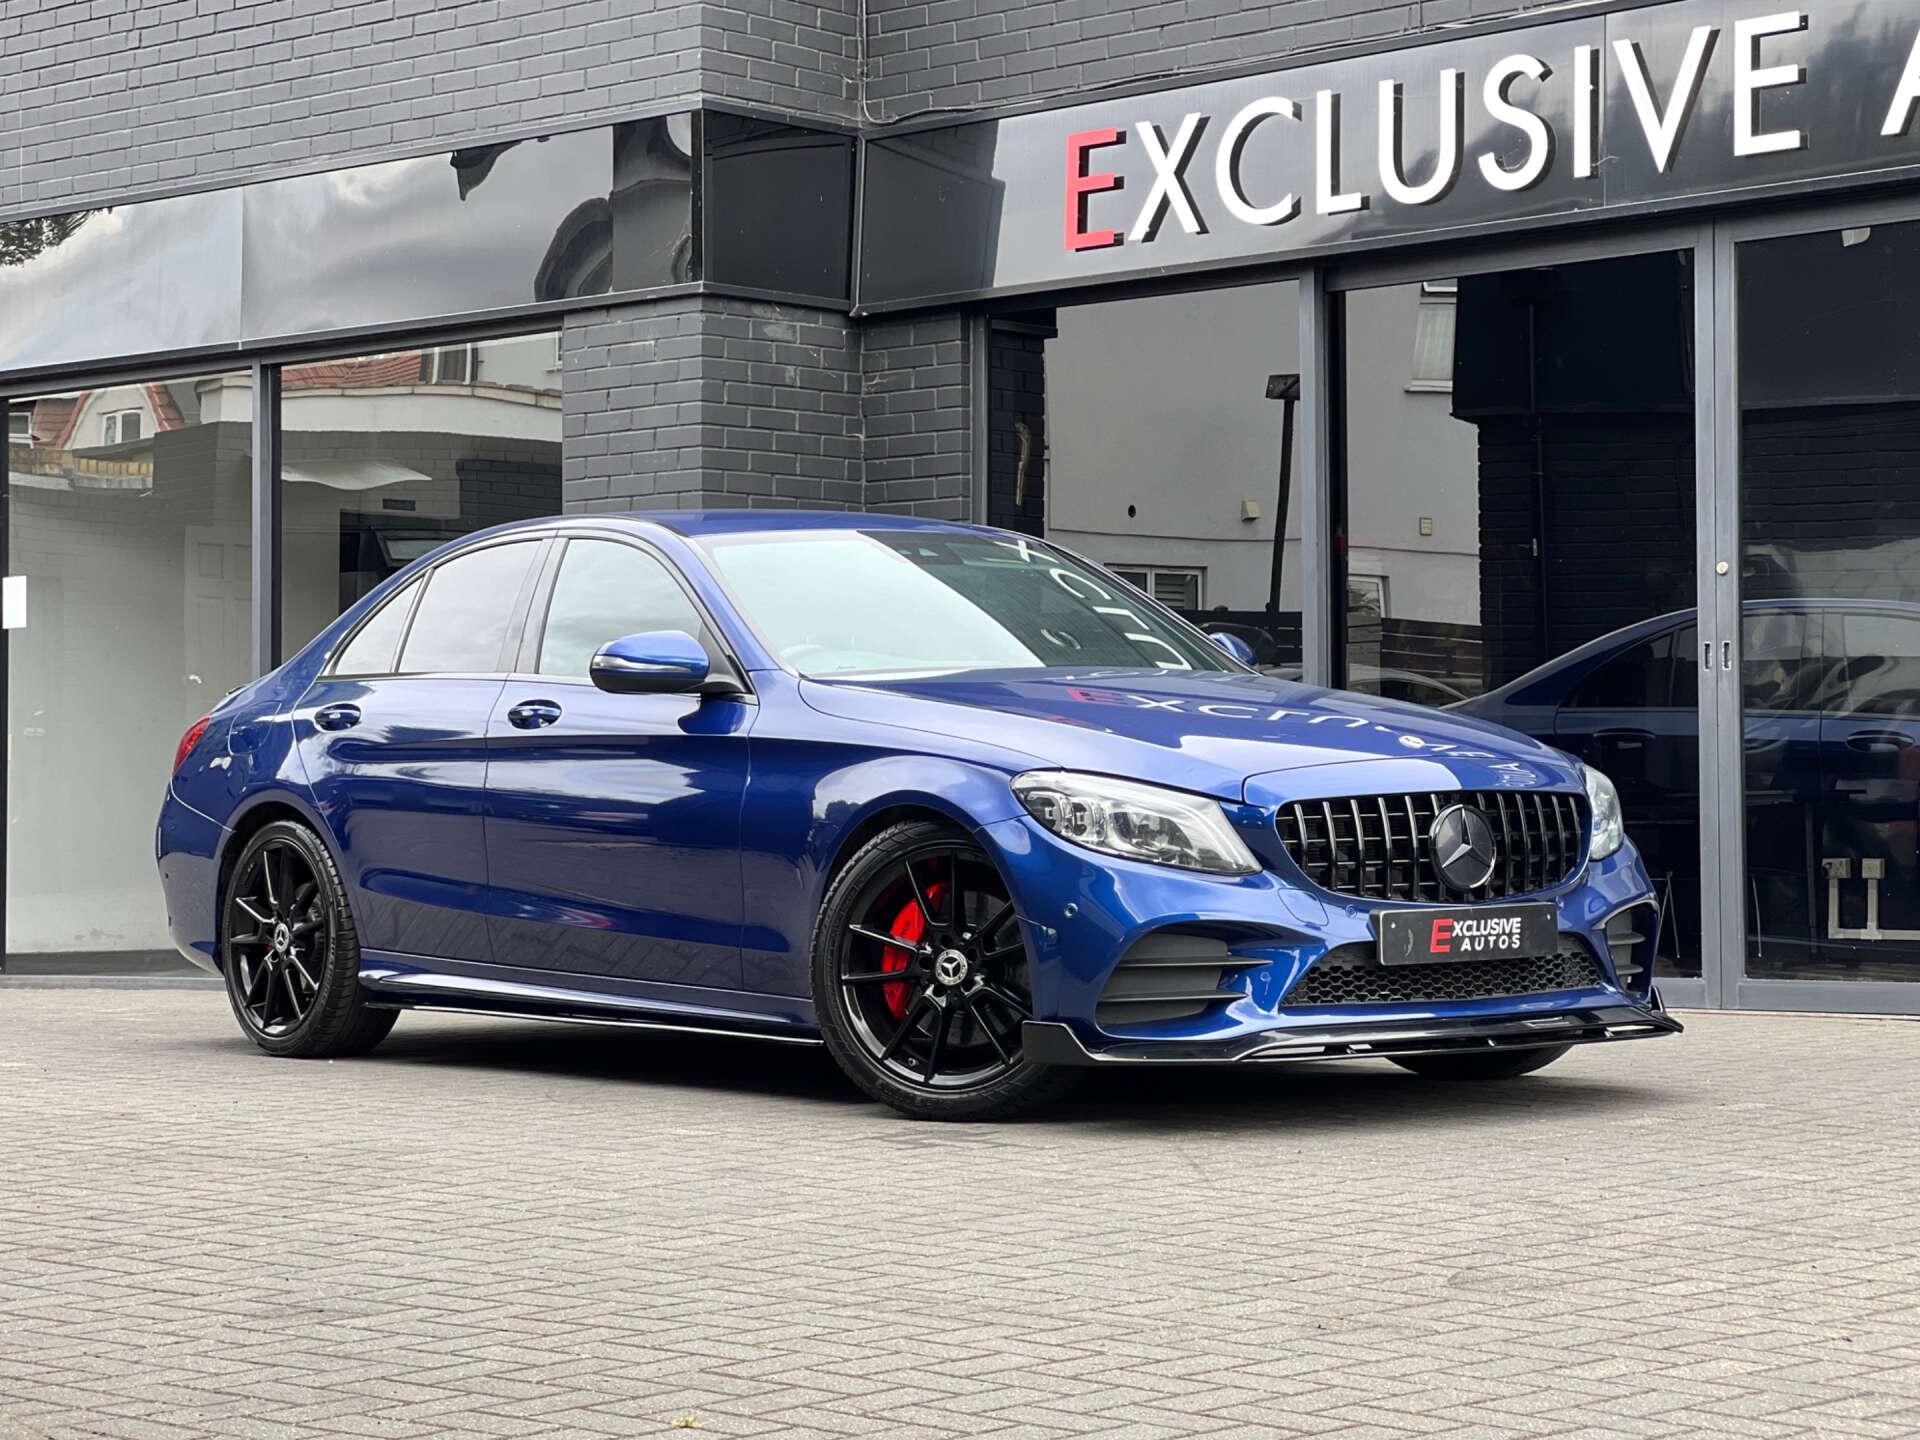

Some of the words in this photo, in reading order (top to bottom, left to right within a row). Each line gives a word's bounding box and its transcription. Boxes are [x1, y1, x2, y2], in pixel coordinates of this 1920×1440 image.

[1065, 11, 1804, 250] EXCLUSIVE
[1430, 917, 1521, 952] EXCLUSIVE
[1460, 934, 1520, 952] AUTOS
